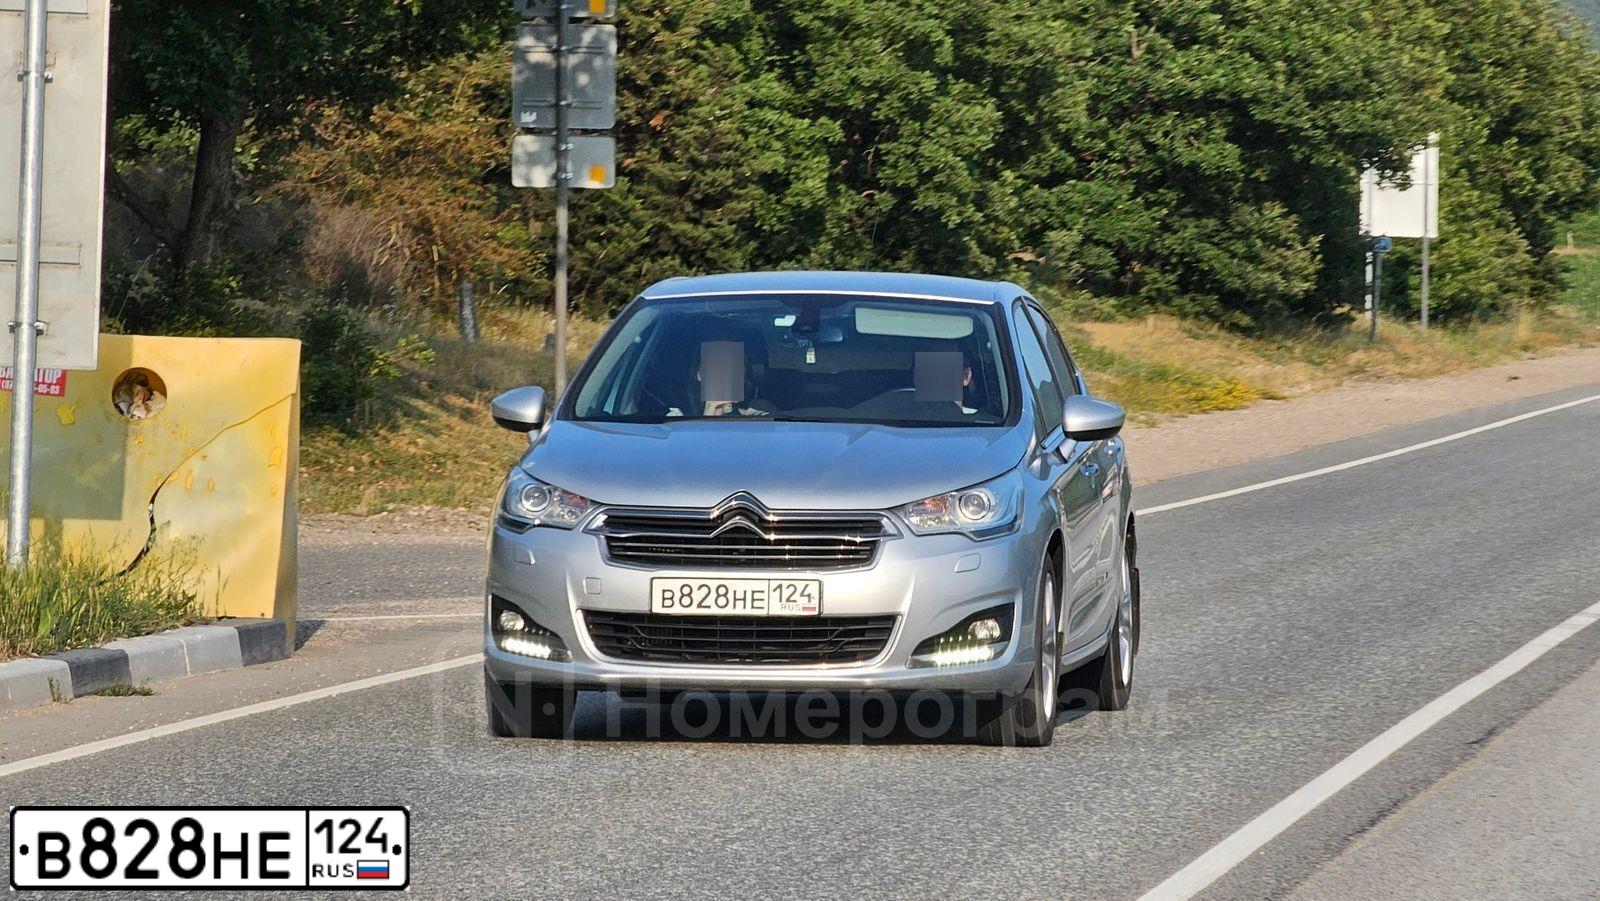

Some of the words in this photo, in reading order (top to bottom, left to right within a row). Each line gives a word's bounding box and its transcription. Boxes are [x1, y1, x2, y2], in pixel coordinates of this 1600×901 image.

[661, 583, 765, 610] В828НЕ
[772, 583, 812, 603] 124
[780, 603, 801, 611] RUS
